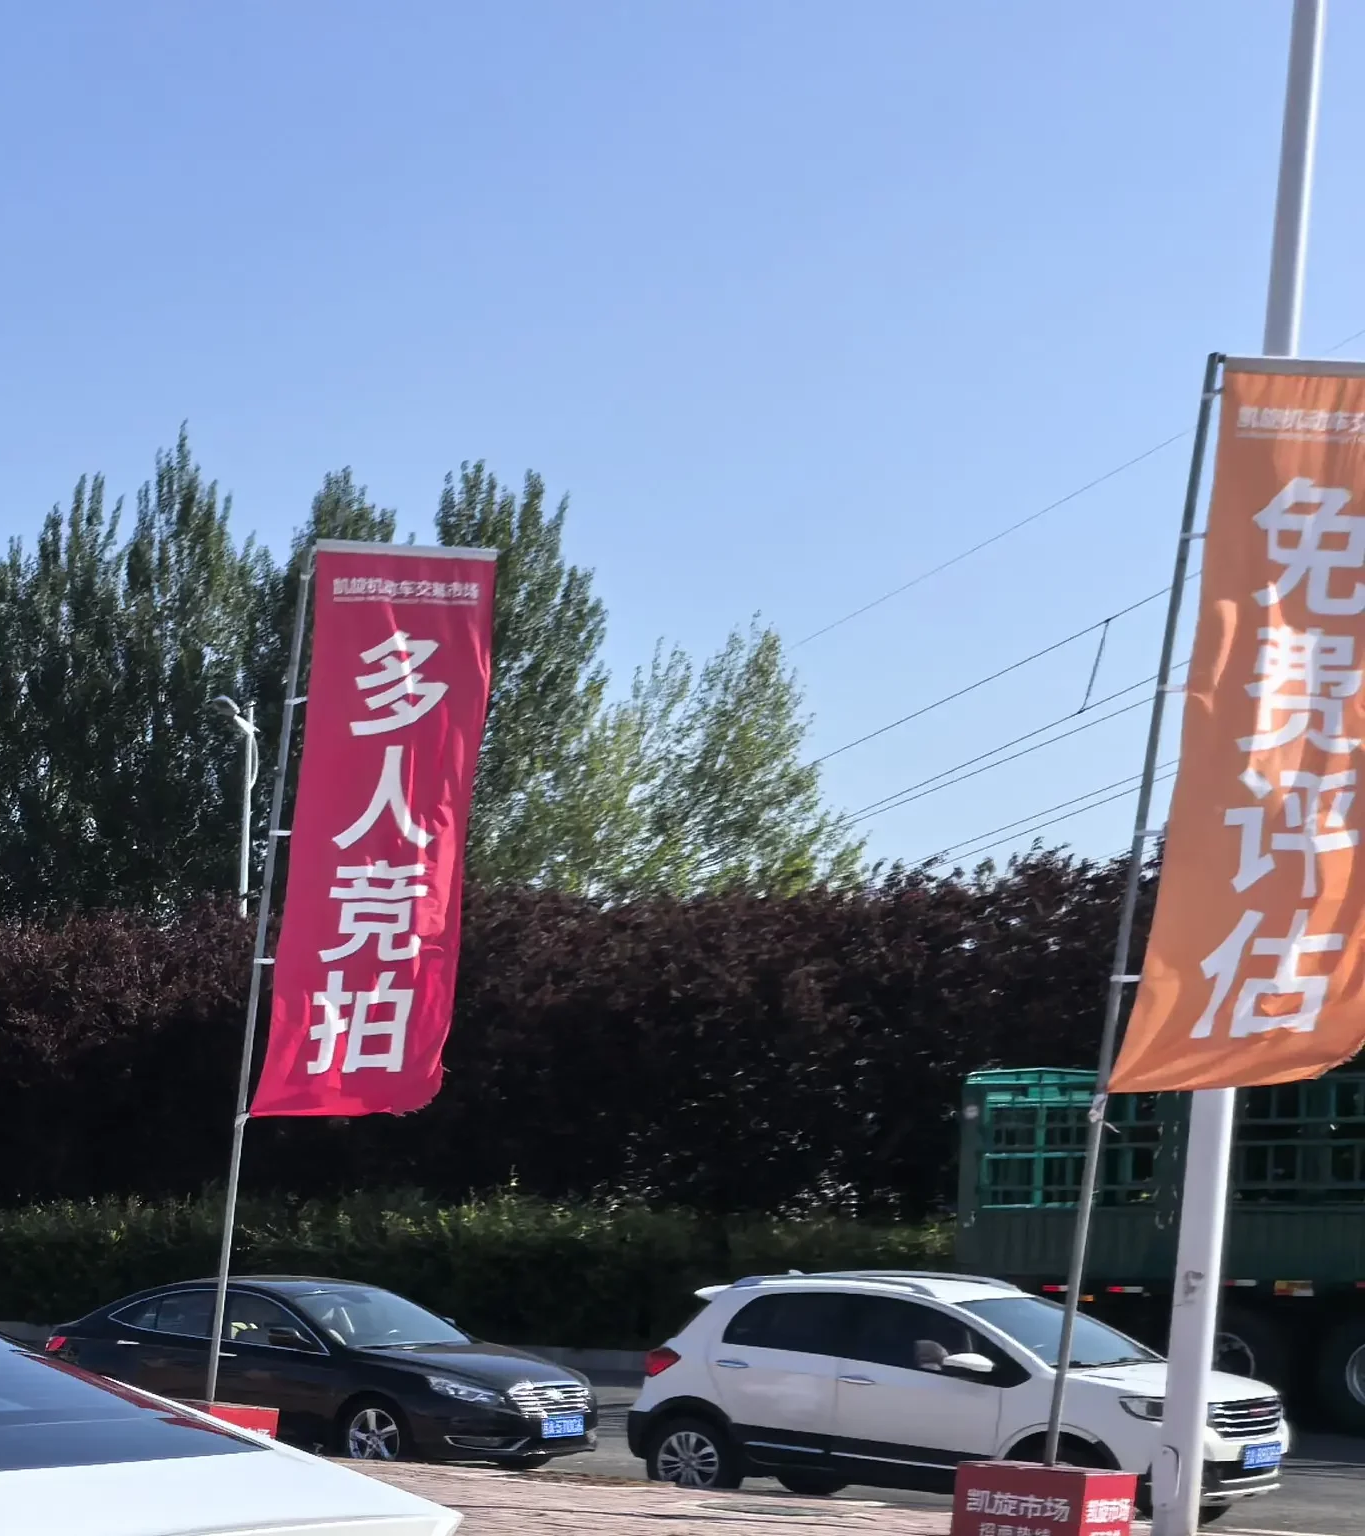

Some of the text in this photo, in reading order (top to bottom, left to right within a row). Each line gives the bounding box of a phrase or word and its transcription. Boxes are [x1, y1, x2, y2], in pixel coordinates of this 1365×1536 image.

[307, 630, 449, 1075] 多人竞拍
[1189, 475, 1365, 1038] 免费评估
[966, 1488, 1071, 1523] 凯旋市场
